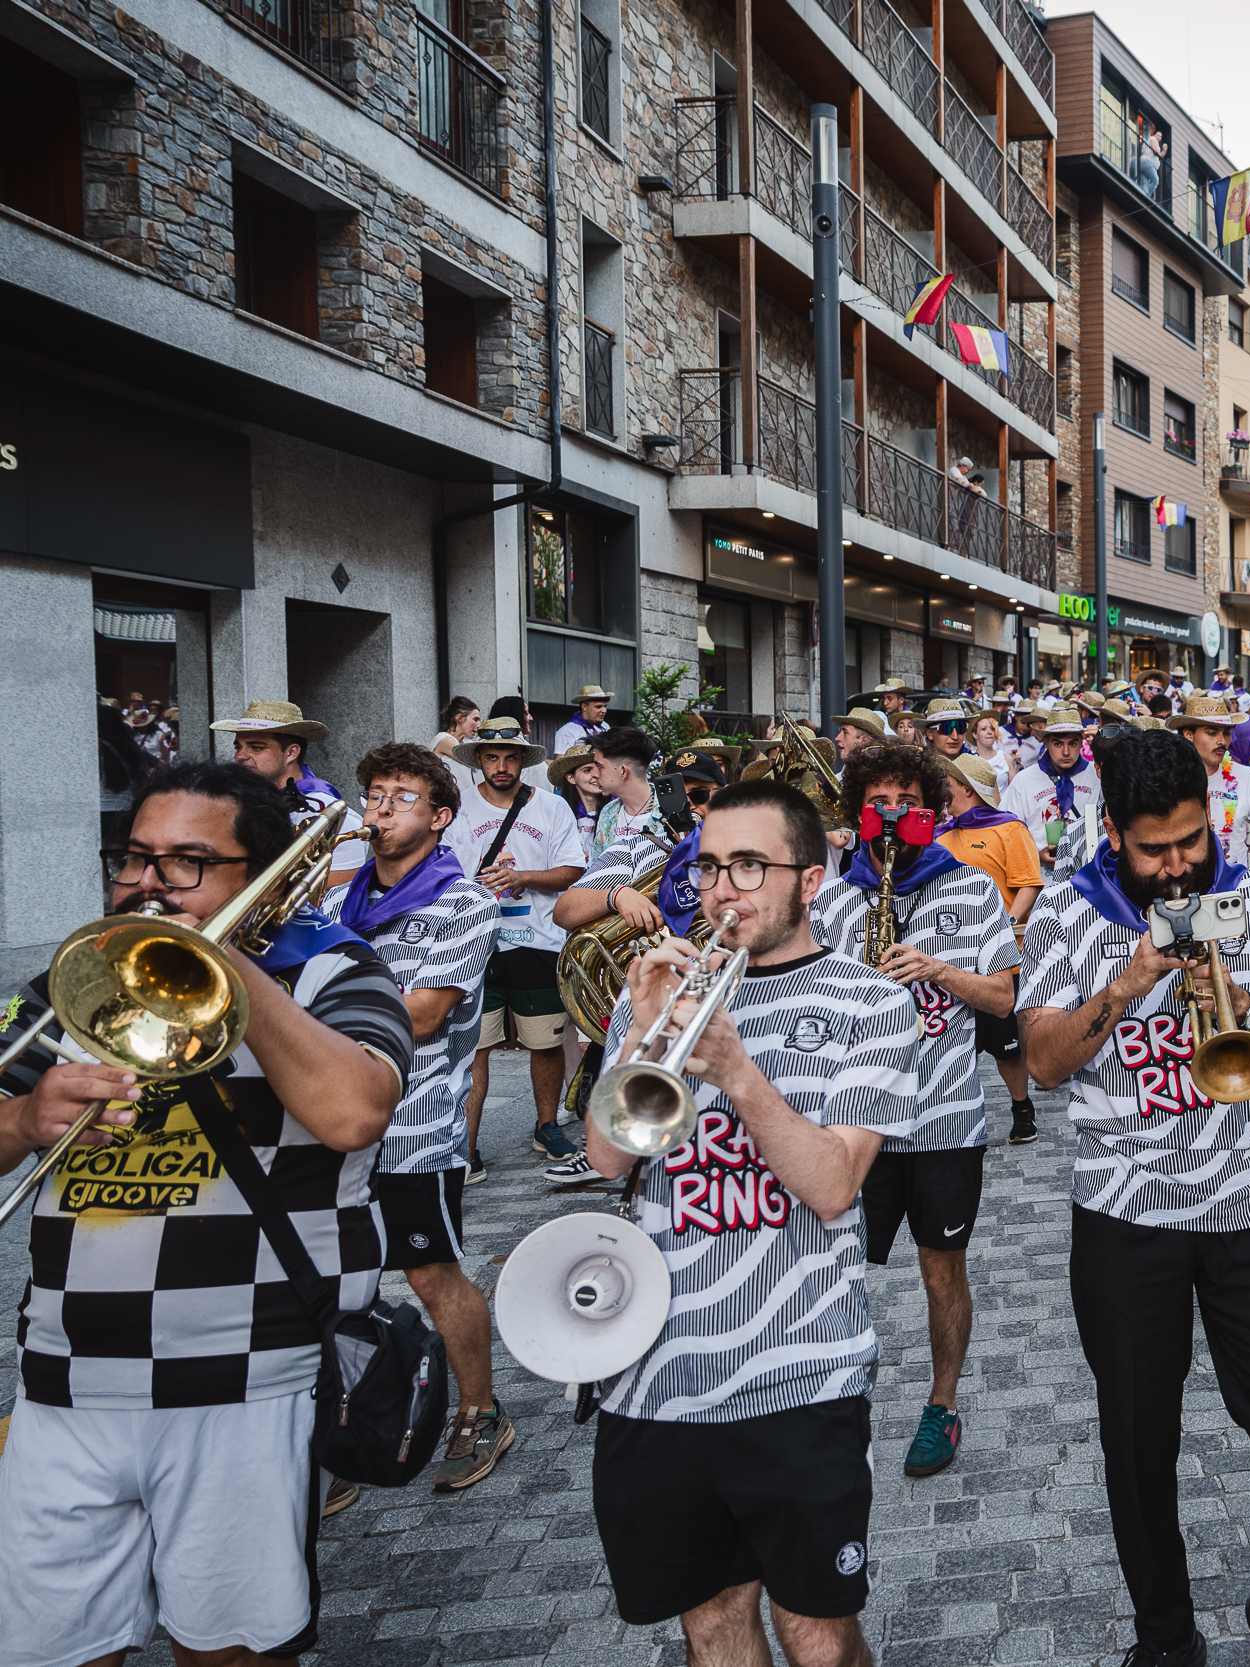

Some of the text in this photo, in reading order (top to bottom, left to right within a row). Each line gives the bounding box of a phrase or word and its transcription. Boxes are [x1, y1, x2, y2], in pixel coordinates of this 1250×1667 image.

[732, 543, 748, 555] PETIT
[748, 548, 764, 560] PARIS
[1103, 943, 1128, 958] VNG
[68, 1181, 194, 1209] groove
